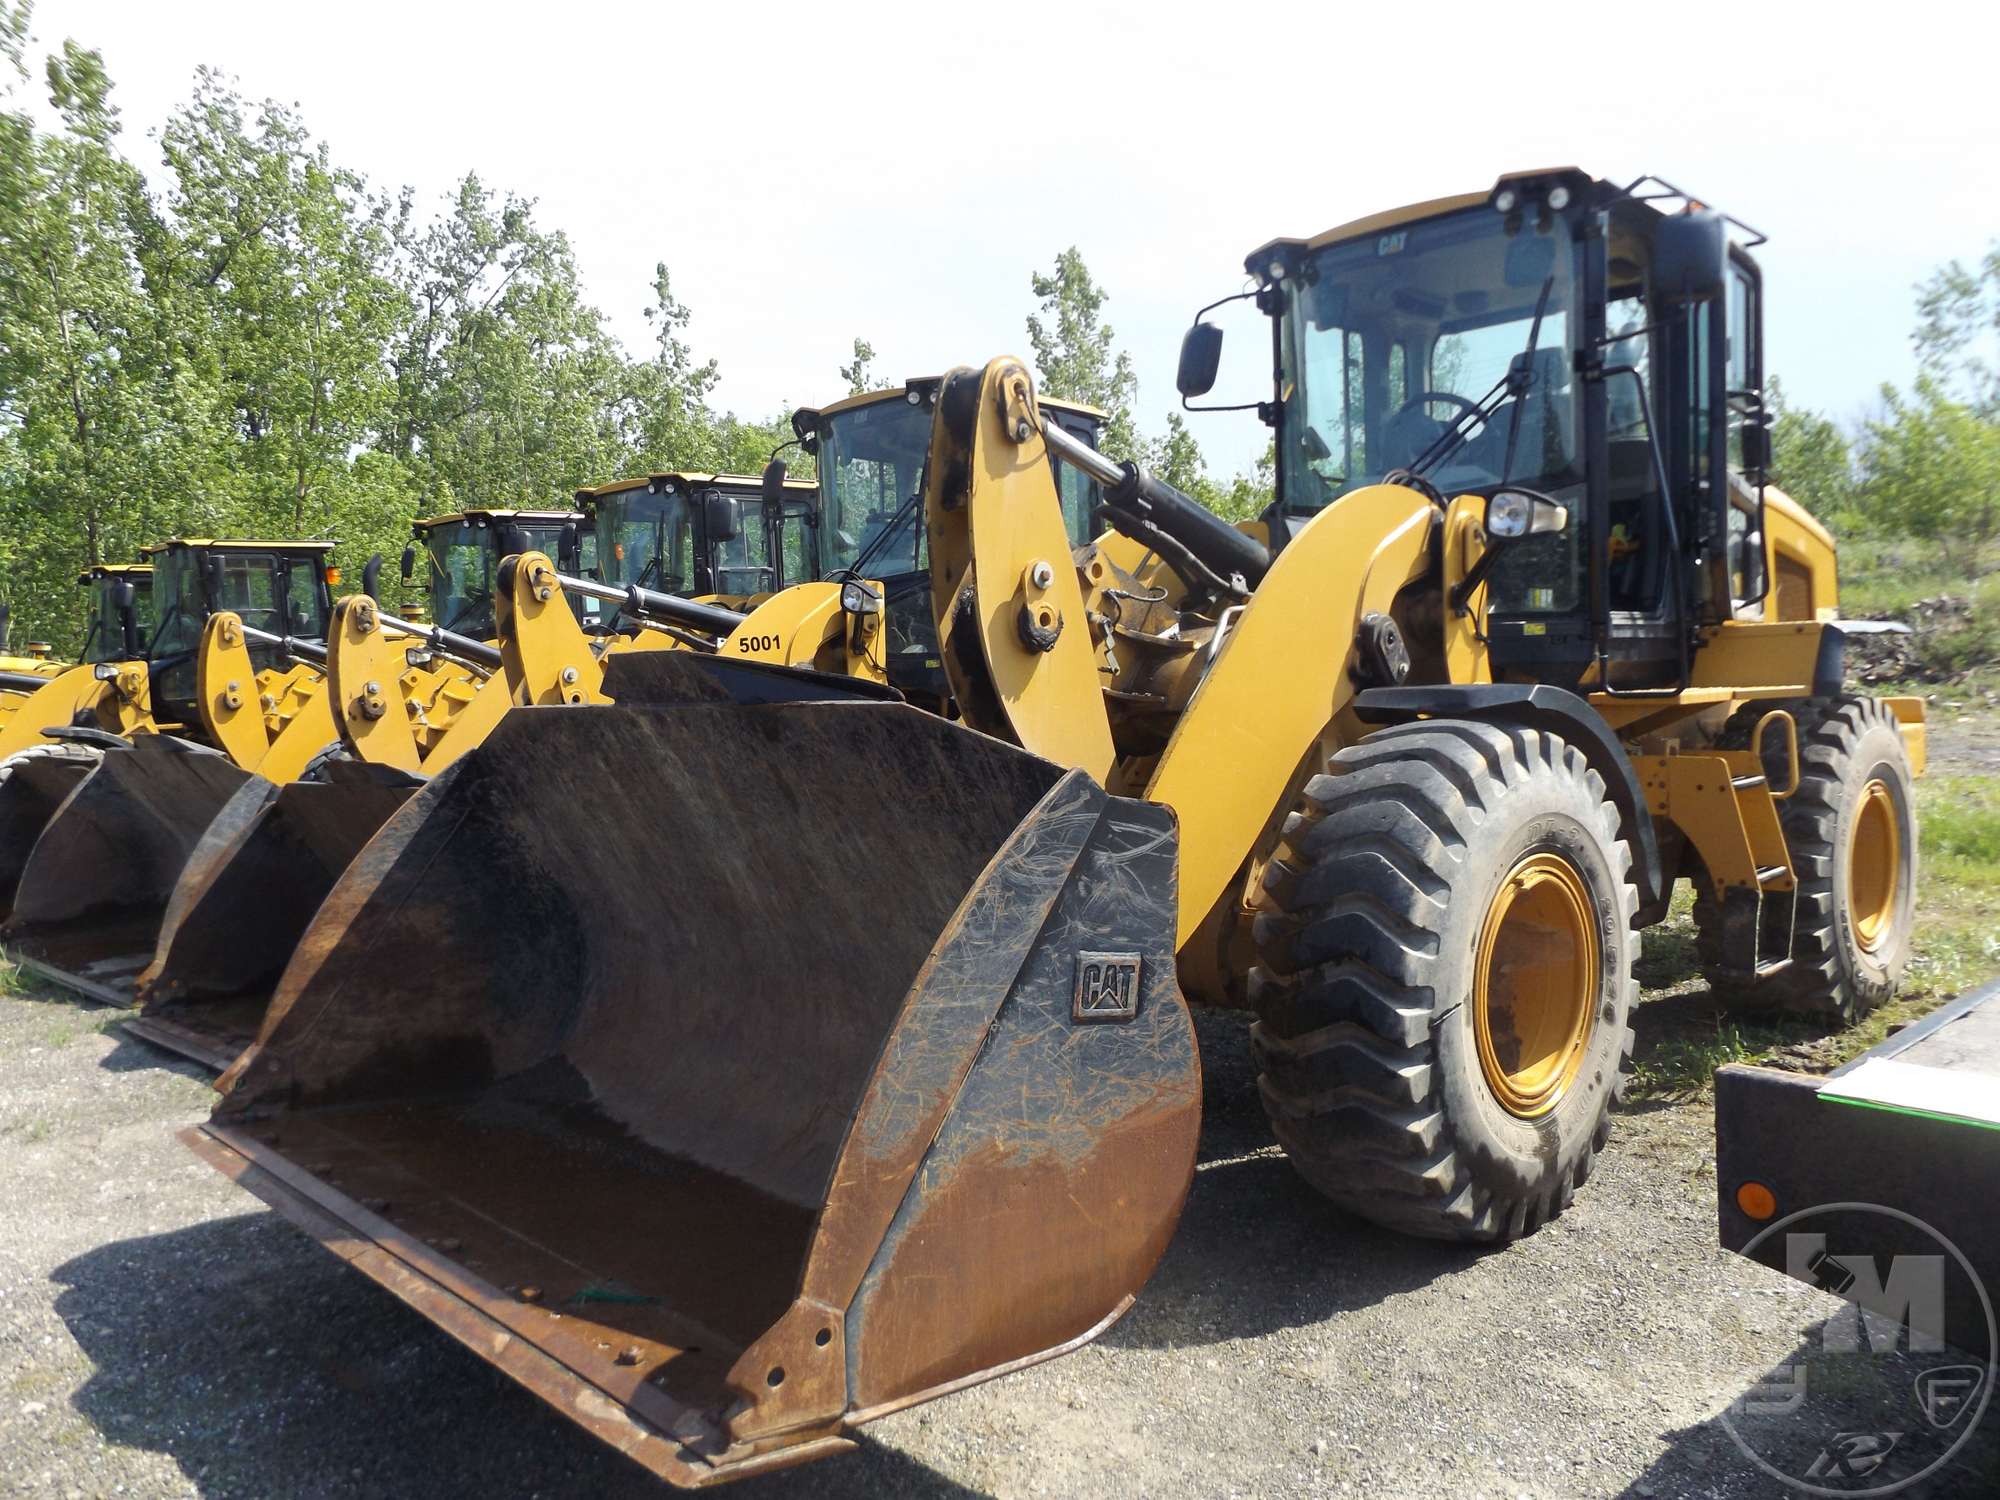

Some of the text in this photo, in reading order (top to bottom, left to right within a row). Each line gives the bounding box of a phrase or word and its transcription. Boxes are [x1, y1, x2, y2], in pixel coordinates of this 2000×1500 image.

[1378, 232, 1408, 257] CAT
[739, 634, 781, 653] 5001
[1081, 963, 1137, 1010] CAT
